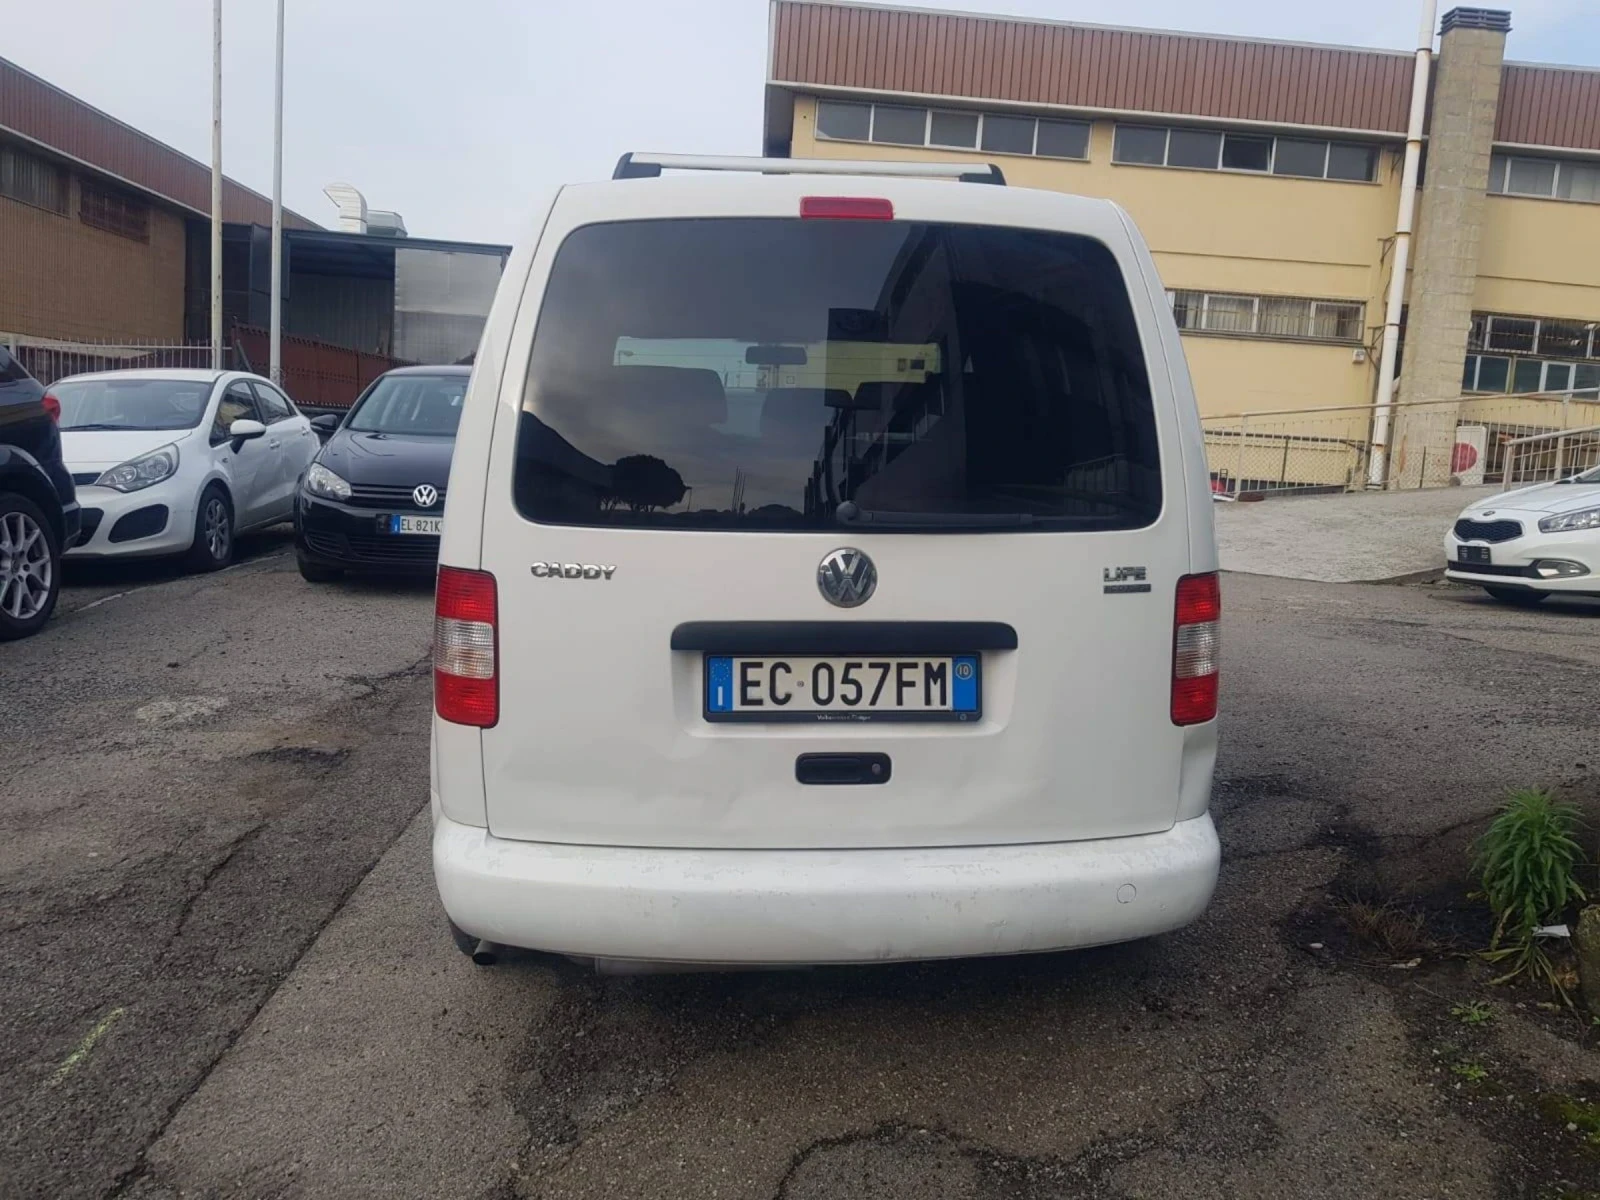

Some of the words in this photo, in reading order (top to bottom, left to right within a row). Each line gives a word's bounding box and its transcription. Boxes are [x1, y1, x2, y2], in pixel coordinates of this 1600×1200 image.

[414, 485, 437, 507] VW
[401, 518, 413, 531] EL
[416, 520, 444, 532] 821K
[531, 561, 617, 580] CADDY
[817, 547, 878, 608] VW
[1103, 566, 1146, 582] LIFE
[740, 661, 793, 707] EC
[811, 661, 948, 707] 057FM
